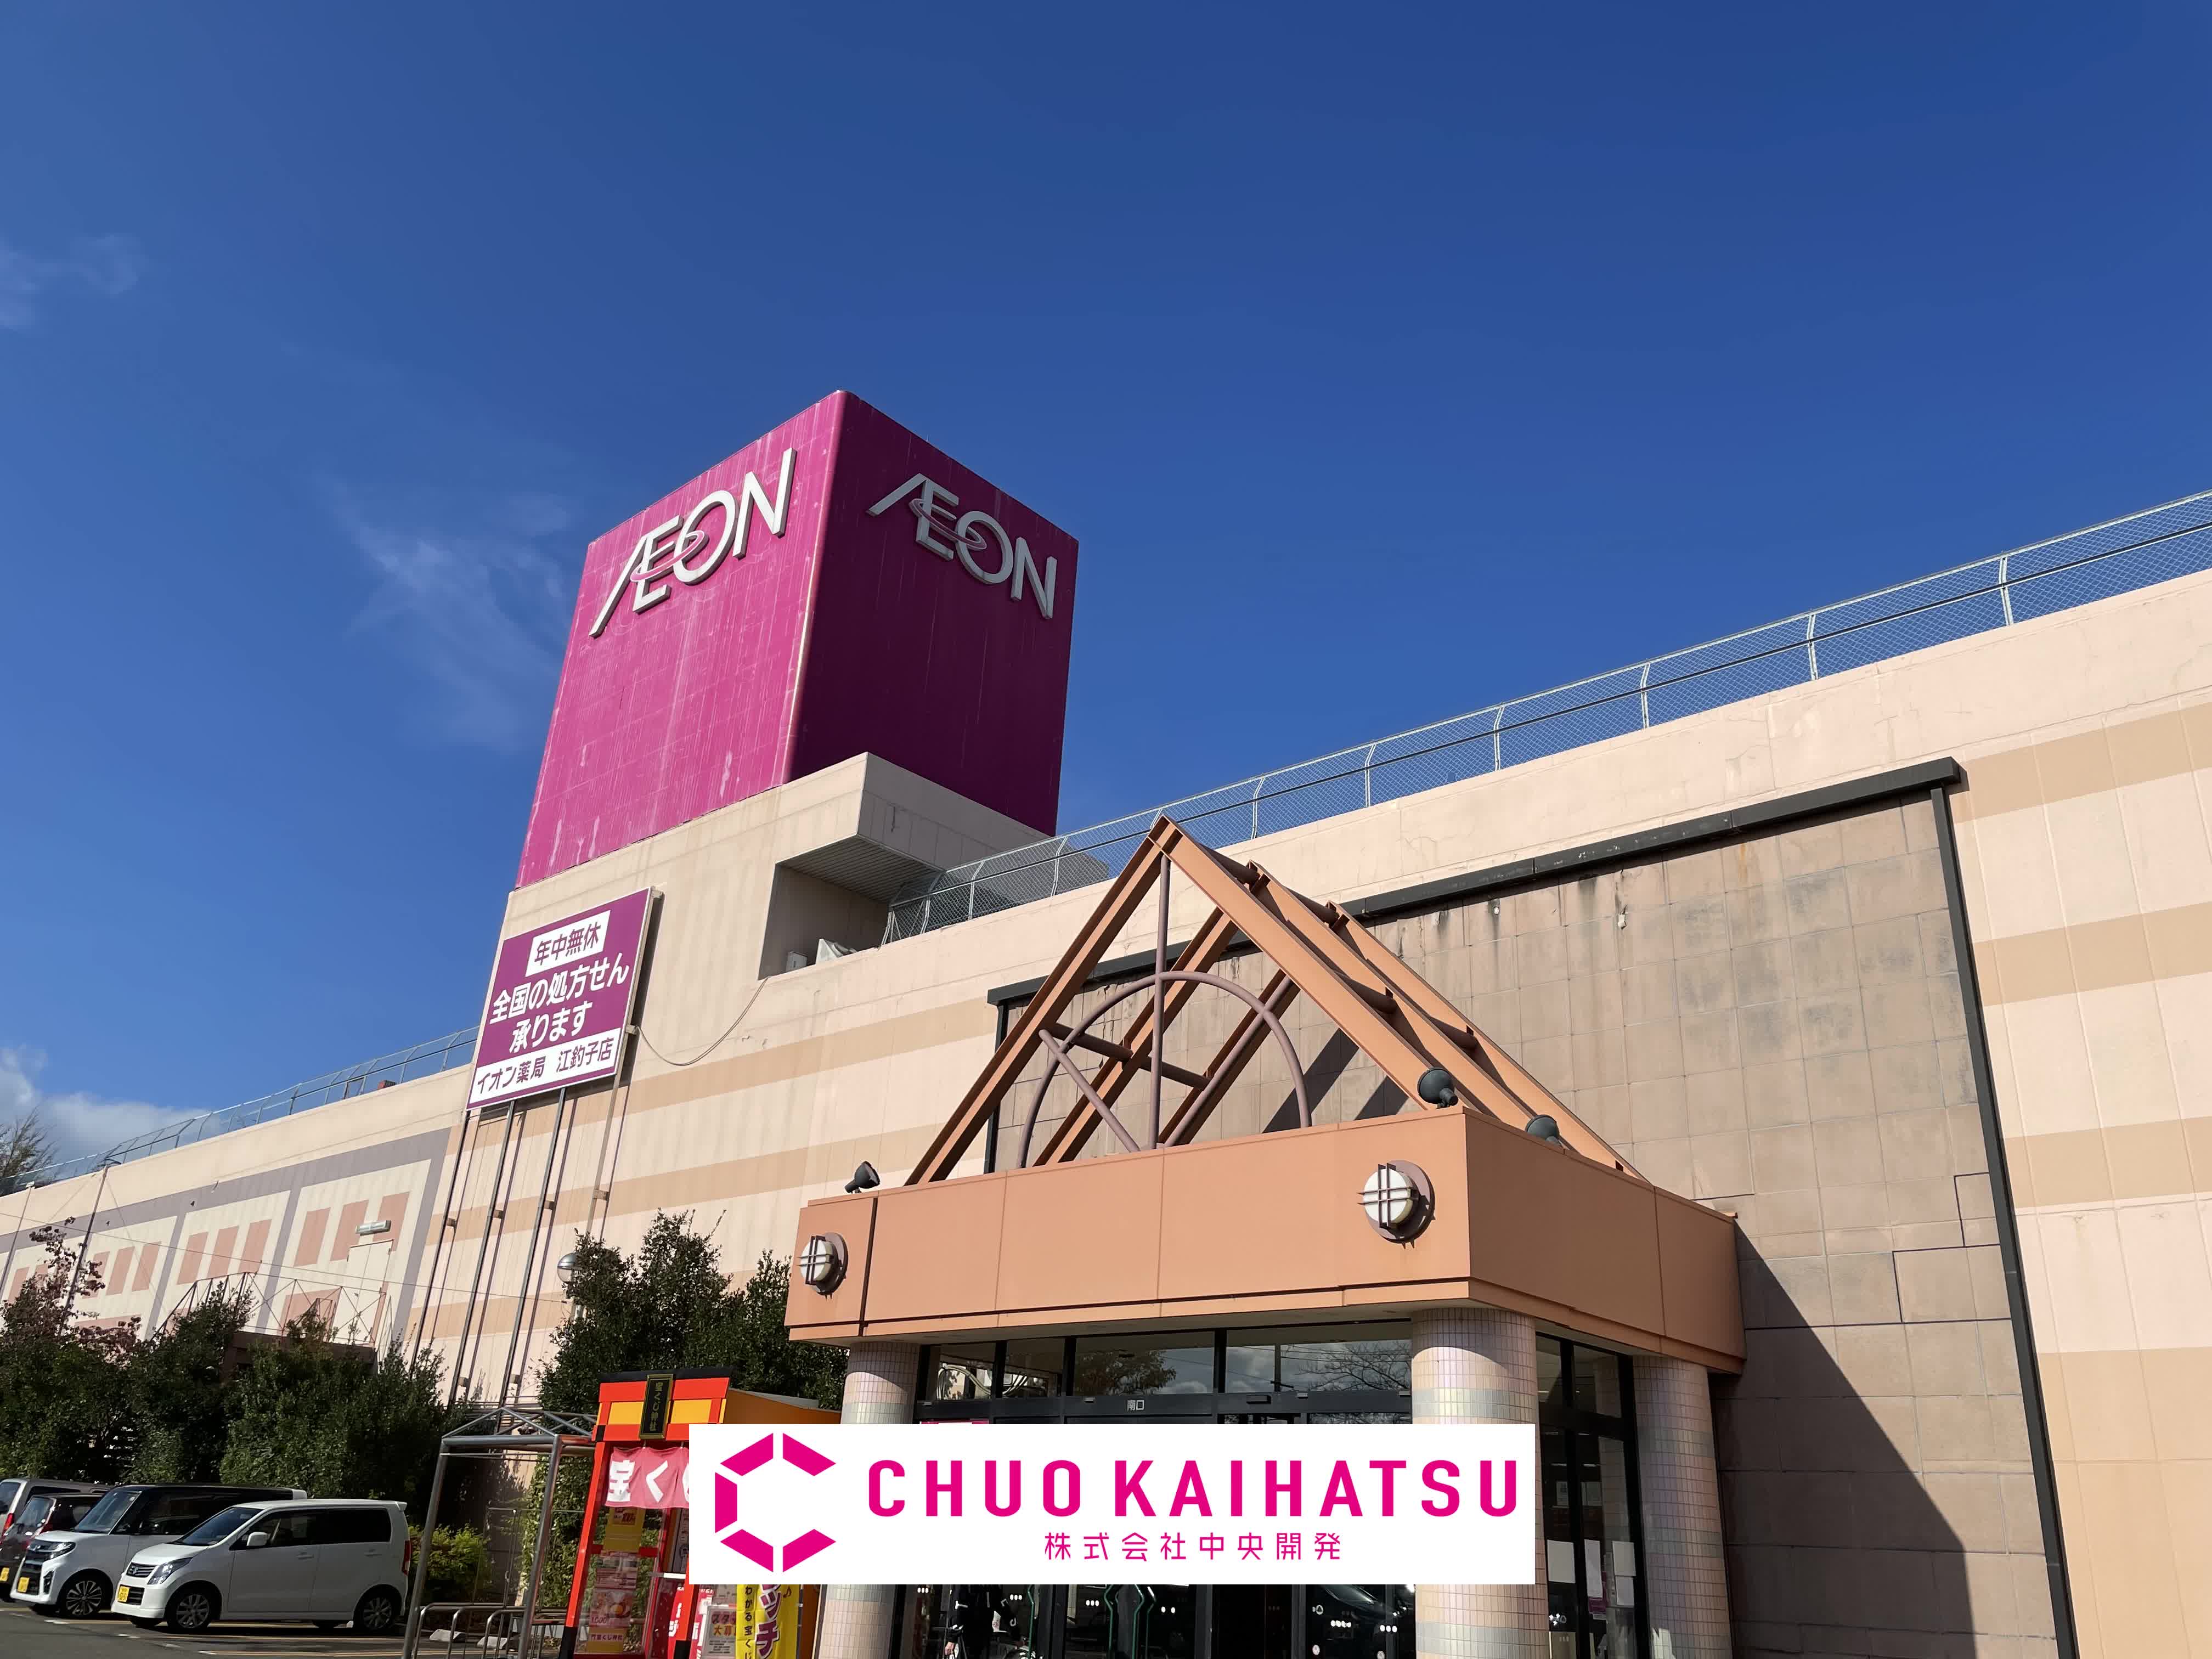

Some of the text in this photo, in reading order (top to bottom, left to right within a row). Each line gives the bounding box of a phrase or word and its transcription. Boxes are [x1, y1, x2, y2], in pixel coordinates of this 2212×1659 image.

[534, 921, 601, 966] 年中無休
[489, 953, 629, 1024] 全国の処方せん
[509, 1001, 593, 1053] 承ります
[477, 1037, 614, 1094] イオン薬局 江釣子店
[1127, 1400, 1144, 1412] 南口
